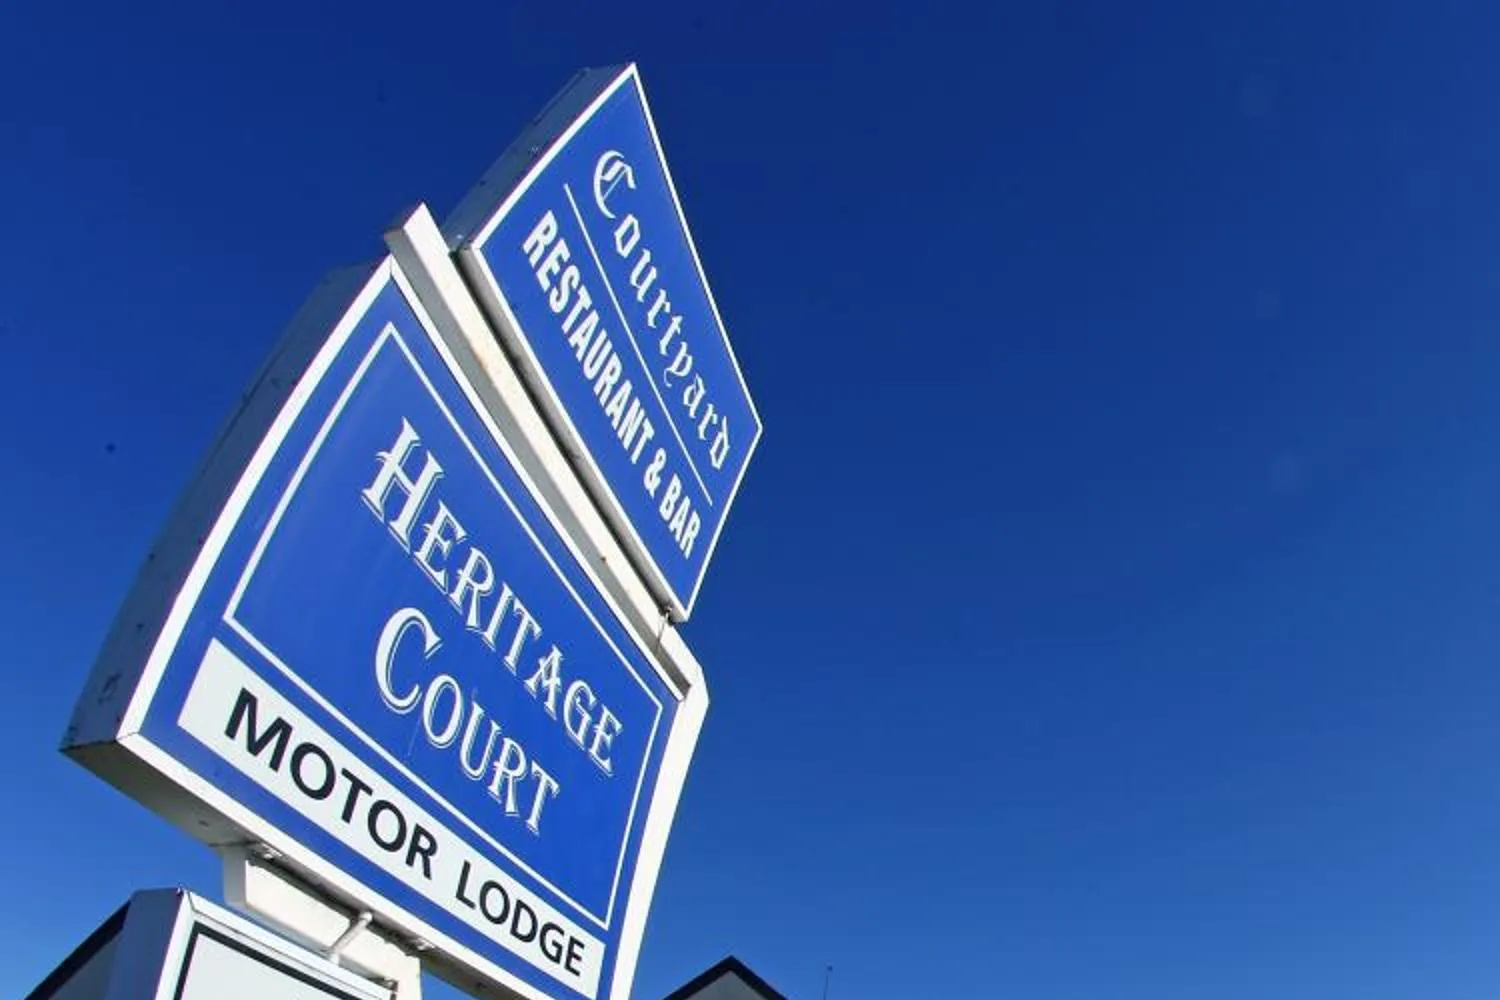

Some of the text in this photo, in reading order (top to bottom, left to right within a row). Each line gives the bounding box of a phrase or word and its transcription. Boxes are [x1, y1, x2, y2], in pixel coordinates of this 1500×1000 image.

[523, 210, 701, 559] RESTAURANT & BAR
[594, 150, 730, 469] Courtyard
[361, 416, 623, 777] HERITAGE
[374, 606, 561, 835] COURT
[224, 687, 585, 977] MOTOR LODGE
